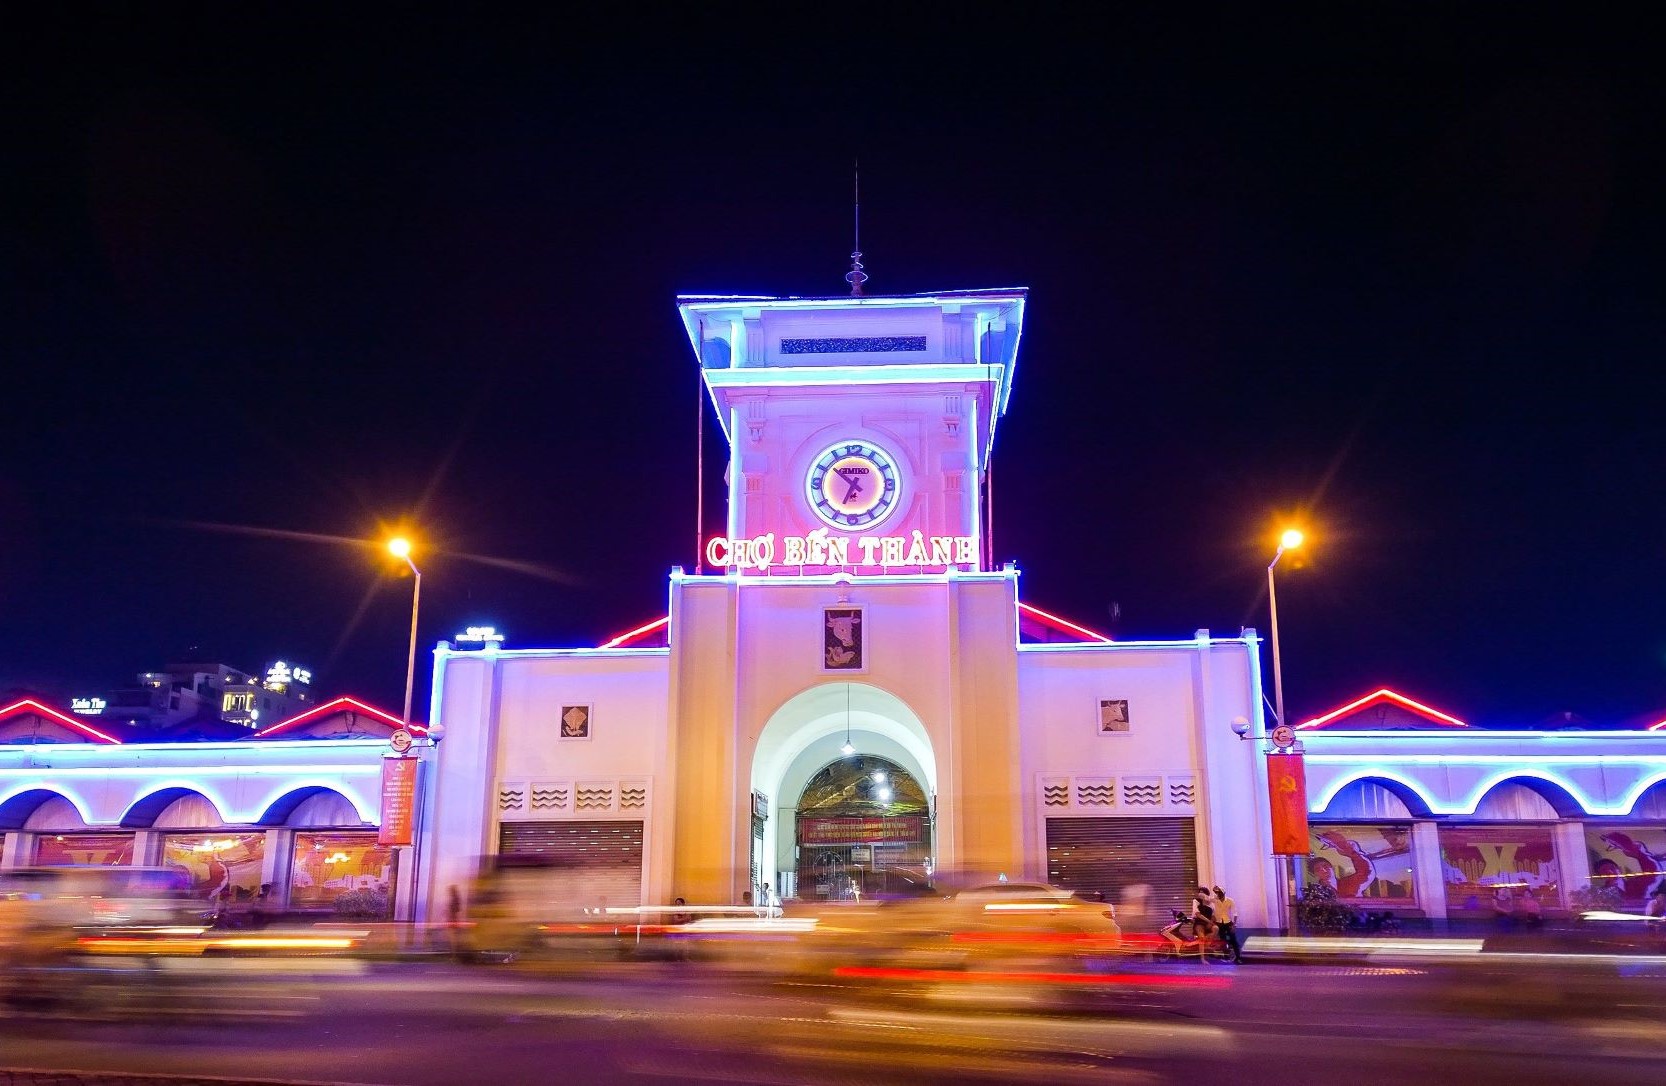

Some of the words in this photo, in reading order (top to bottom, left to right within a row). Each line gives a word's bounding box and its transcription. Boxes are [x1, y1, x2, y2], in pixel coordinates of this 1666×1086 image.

[845, 445, 862, 456] 12
[886, 479, 895, 491] 3
[847, 514, 858, 525] 6
[706, 533, 775, 570] CHỢ
[783, 528, 850, 566] BẾN
[857, 530, 979, 566] THÀNH
